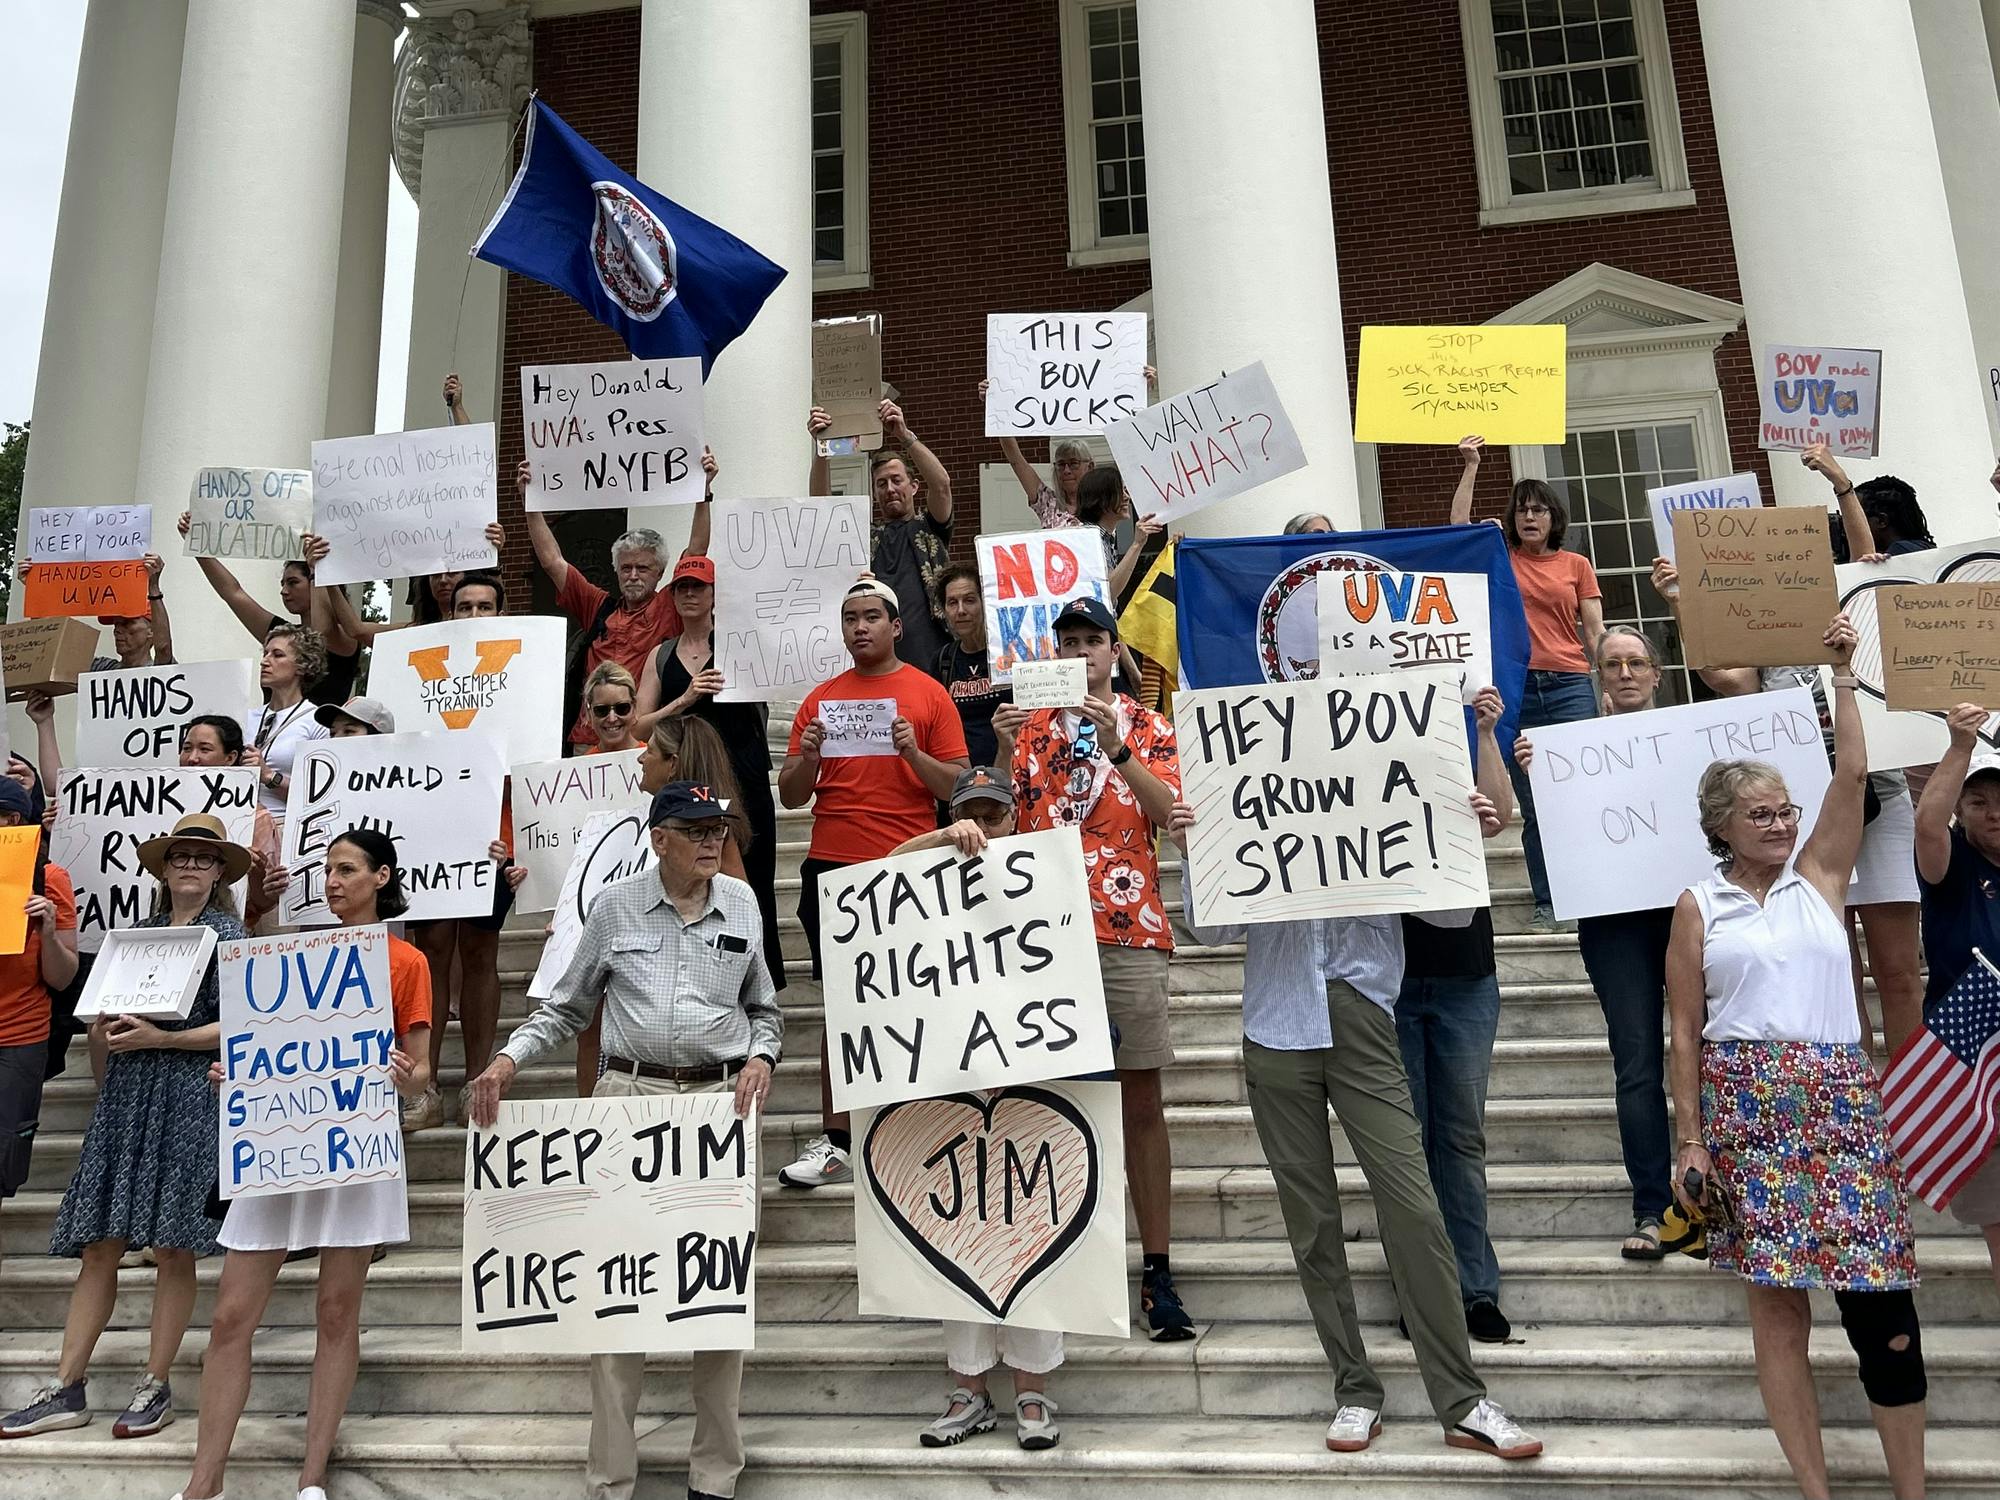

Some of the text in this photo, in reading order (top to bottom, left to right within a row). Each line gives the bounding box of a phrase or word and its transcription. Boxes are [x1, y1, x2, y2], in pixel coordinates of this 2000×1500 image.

[611, 200, 654, 242] VIRGINIA
[1019, 318, 1114, 352] THIS
[1427, 333, 1484, 353] STOP
[1040, 358, 1101, 391] BOV
[1387, 363, 1562, 379] SICK RACIST REGIME
[1775, 352, 1870, 377] BOV made
[533, 373, 580, 415] Hey
[1403, 381, 1518, 397] SIC SEMPER
[1410, 398, 1499, 418] TYRANNIS
[415, 444, 496, 478] hostility
[1141, 412, 1274, 503] WHAT?
[198, 471, 309, 499] HANDS OFF
[541, 464, 564, 492] is
[40, 512, 74, 528] HEY
[225, 499, 255, 521] OUR
[326, 489, 394, 532] against
[473, 479, 488, 499] of
[34, 531, 144, 553] KEEP YOUR
[727, 503, 867, 570] UVA
[1767, 528, 1778, 536] is
[1803, 523, 1820, 535] the
[992, 538, 1080, 600] NO
[1701, 543, 1813, 562] WRONG side of
[39, 564, 147, 583] HANDS OFF
[1698, 568, 1821, 587] American Values
[1342, 572, 1459, 625] UVA
[1893, 594, 1950, 611] REMOVAL
[1955, 599, 1975, 608] OF
[1904, 617, 1994, 630] PROGRAMS IS
[724, 625, 855, 690] MAG
[1333, 631, 1474, 660] IS A STATE
[1893, 647, 1943, 666] LIBERTY
[420, 671, 508, 698] SIC SEMPER
[1950, 670, 1985, 687] ALL
[90, 674, 194, 720] HANDS
[423, 692, 494, 713] TYRANNIS
[822, 703, 887, 714] WAHOOS
[828, 714, 873, 724] STAND
[1196, 683, 1436, 765] HEY BOV
[1545, 710, 1819, 783] DON'T TREAD
[63, 773, 185, 817] THANK
[1233, 760, 1420, 830] GROW A
[521, 820, 559, 850] This
[1600, 800, 1658, 844] ON
[1227, 801, 1439, 897] SPINE!
[221, 943, 242, 962] We
[248, 941, 272, 957] love
[277, 939, 299, 954] our
[245, 944, 374, 1013] UVA
[227, 1027, 395, 1081] FACULTY
[841, 998, 1078, 1085] MY ASS
[227, 1075, 395, 1127] STAND WITH
[327, 1126, 399, 1173] RYAN
[473, 1119, 746, 1190] KEEP JIM
[923, 1131, 1059, 1225] JIM
[473, 1230, 756, 1314] FIRE THE BOV
